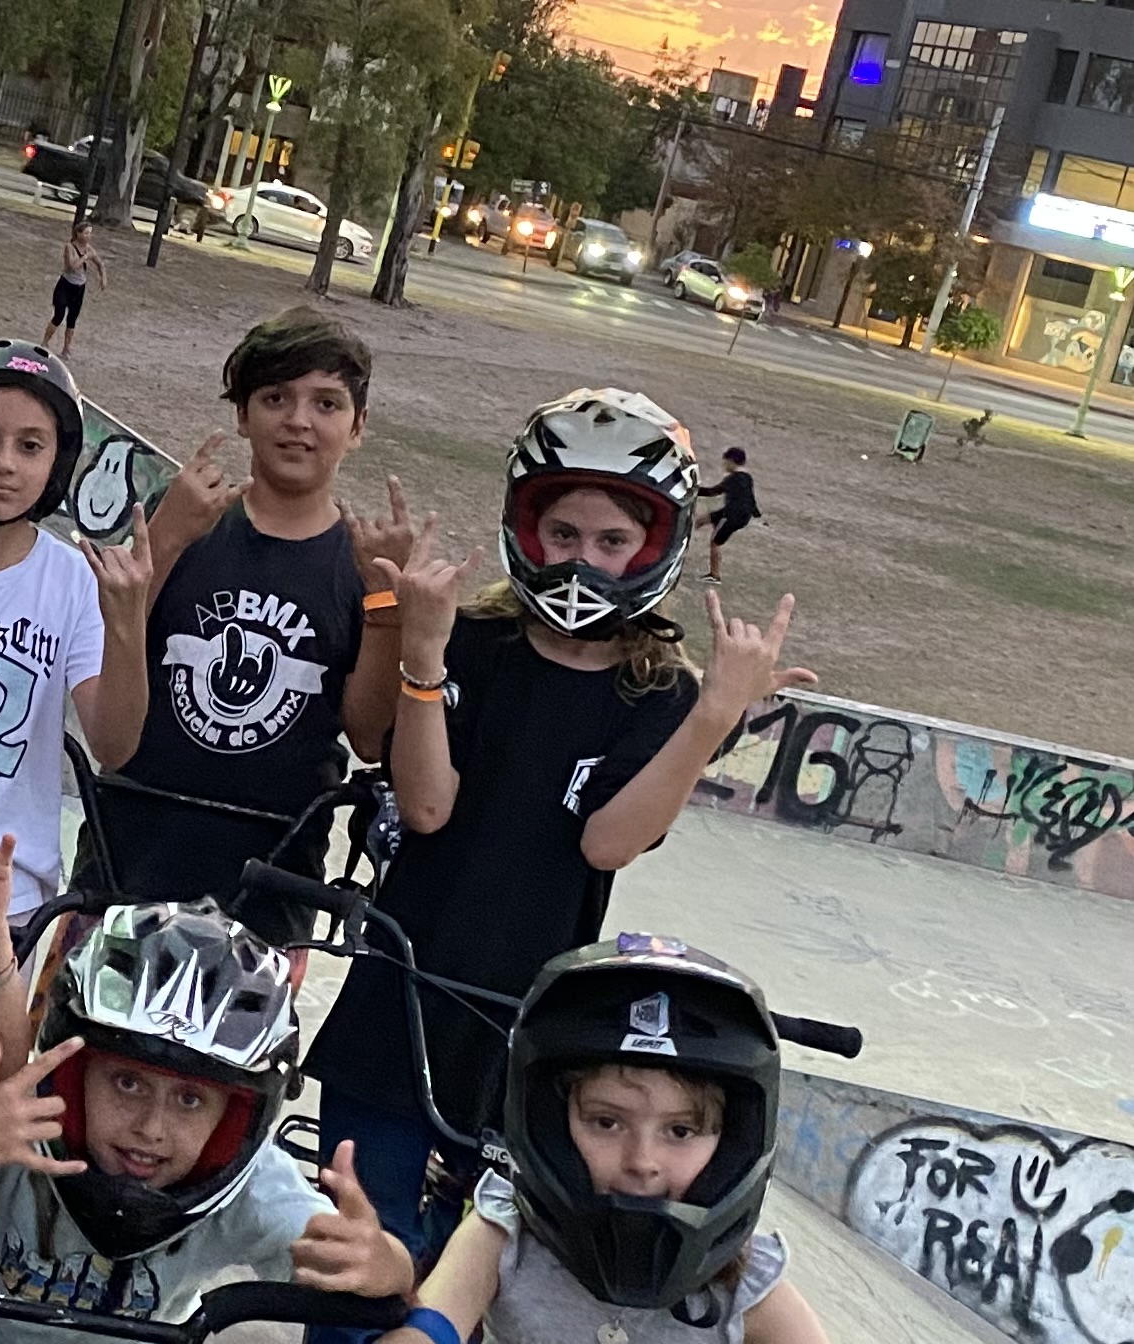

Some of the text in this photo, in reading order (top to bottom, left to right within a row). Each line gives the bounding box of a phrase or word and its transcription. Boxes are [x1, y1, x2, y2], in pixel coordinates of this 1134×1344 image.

[10, 617, 60, 679] City
[195, 590, 316, 652] ABBMX
[174, 668, 302, 747] escuela de bmx
[895, 1138, 996, 1202] FOR
